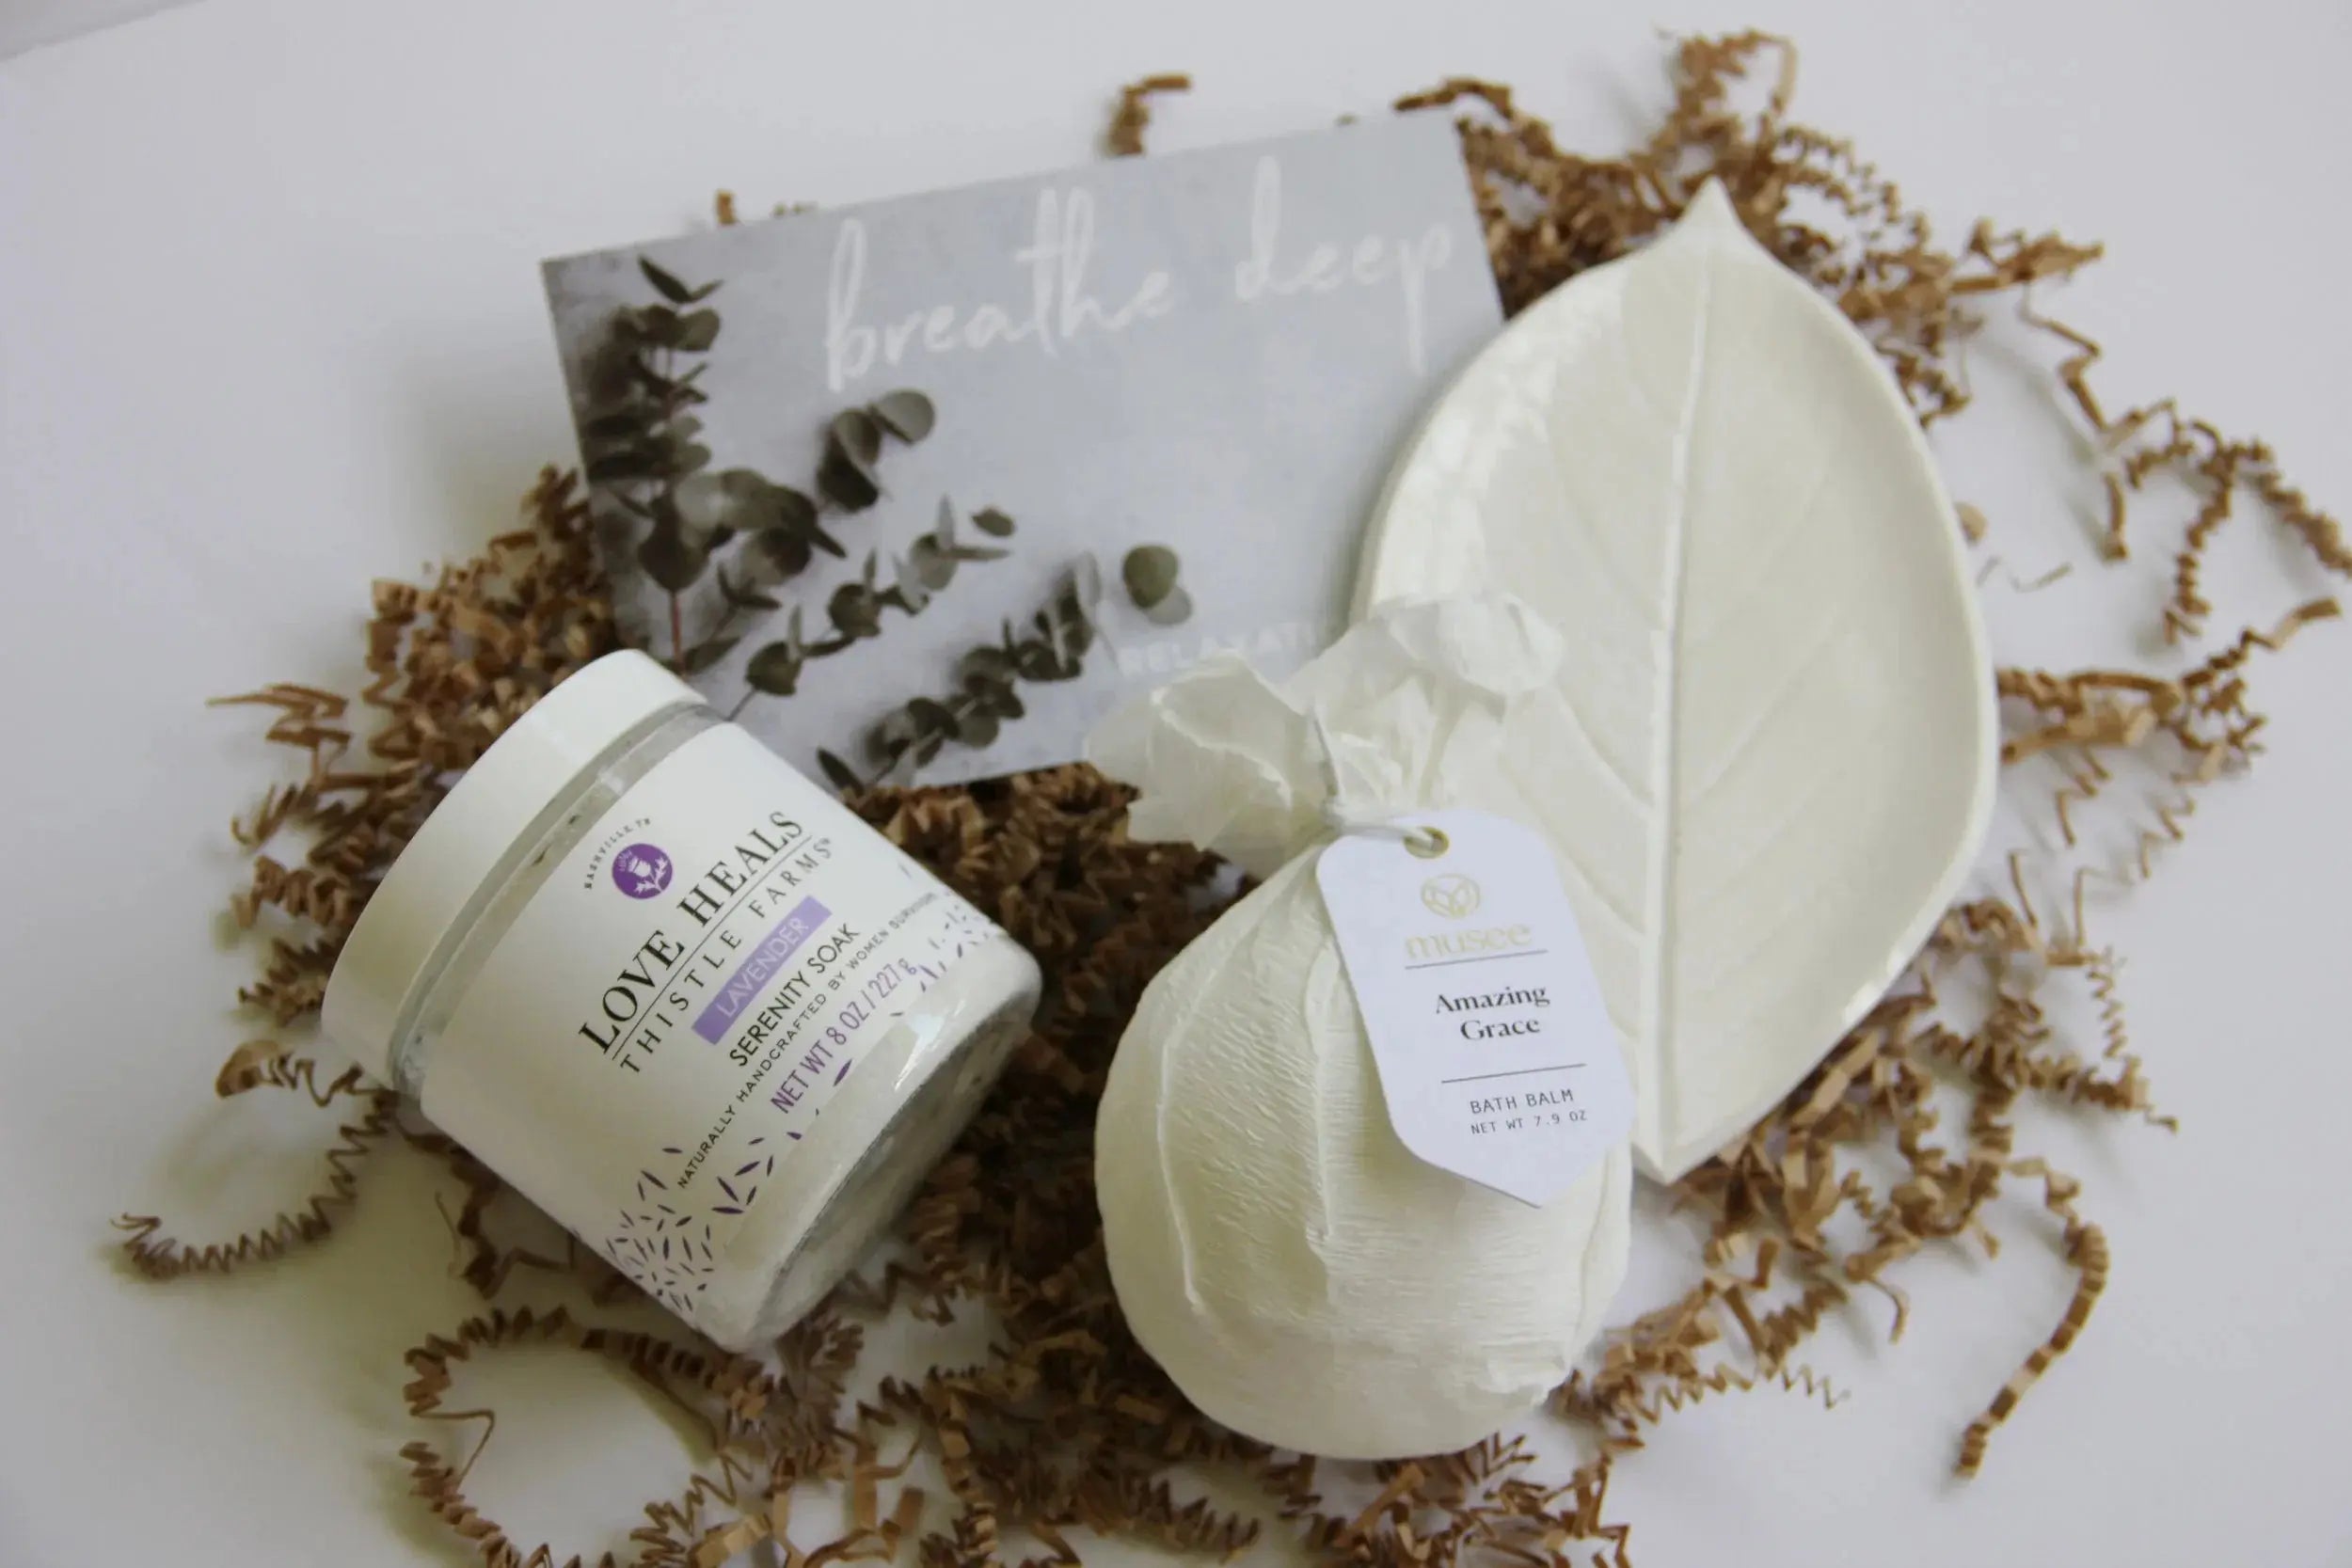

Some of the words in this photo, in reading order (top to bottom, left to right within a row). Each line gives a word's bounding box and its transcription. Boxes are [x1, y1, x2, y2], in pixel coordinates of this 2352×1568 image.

[824, 187, 1176, 392] breathe
[1234, 153, 1452, 374] deep
[578, 929, 685, 1053] LOVE
[676, 811, 803, 927] HEALS
[620, 929, 742, 1073] THISTLE
[716, 916, 809, 1019] LAVENDER
[729, 971, 811, 1067] SERENITY
[807, 923, 860, 974] SOAK
[1436, 986, 1550, 1015] Amazing
[676, 1104, 736, 1189] NATURALLY
[736, 993, 827, 1102] HANDCRAFTED
[828, 971, 846, 991] BY
[847, 929, 889, 970] WOMEN
[771, 1069, 809, 1114] NET
[801, 1039, 834, 1074] WT
[826, 1026, 847, 1046] 8
[839, 1000, 870, 1030] OZ
[867, 963, 901, 999] 227
[898, 958, 917, 975] g
[1460, 1018, 1541, 1040] Grace
[1470, 1096, 1518, 1115] BATH
[1526, 1088, 1574, 1108] BALM
[1470, 1121, 1498, 1135] NET
[1506, 1117, 1524, 1131] WT
[1534, 1114, 1561, 1127] 7.9
[1568, 1110, 1587, 1122] OZ
